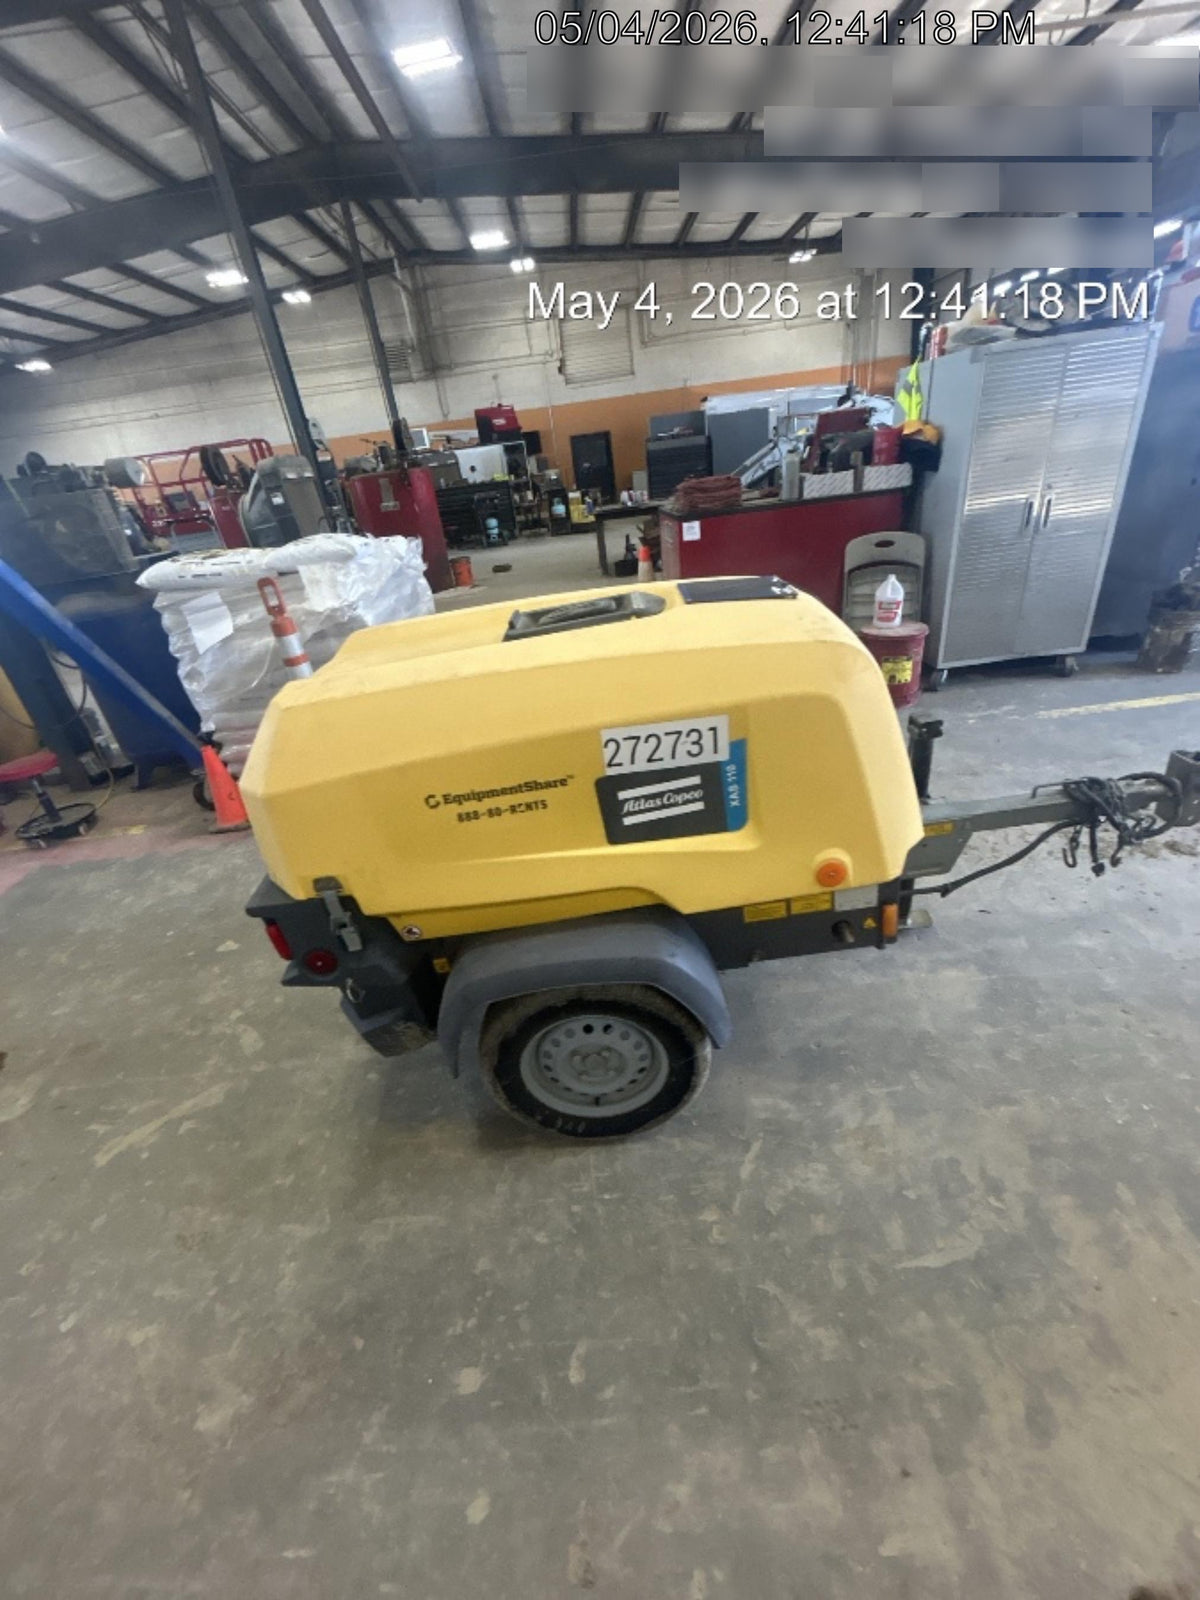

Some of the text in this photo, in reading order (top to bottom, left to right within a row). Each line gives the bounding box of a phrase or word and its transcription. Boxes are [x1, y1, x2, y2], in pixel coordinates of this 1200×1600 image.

[603, 726, 719, 769] 272731
[622, 788, 704, 815] Atlas Copco
